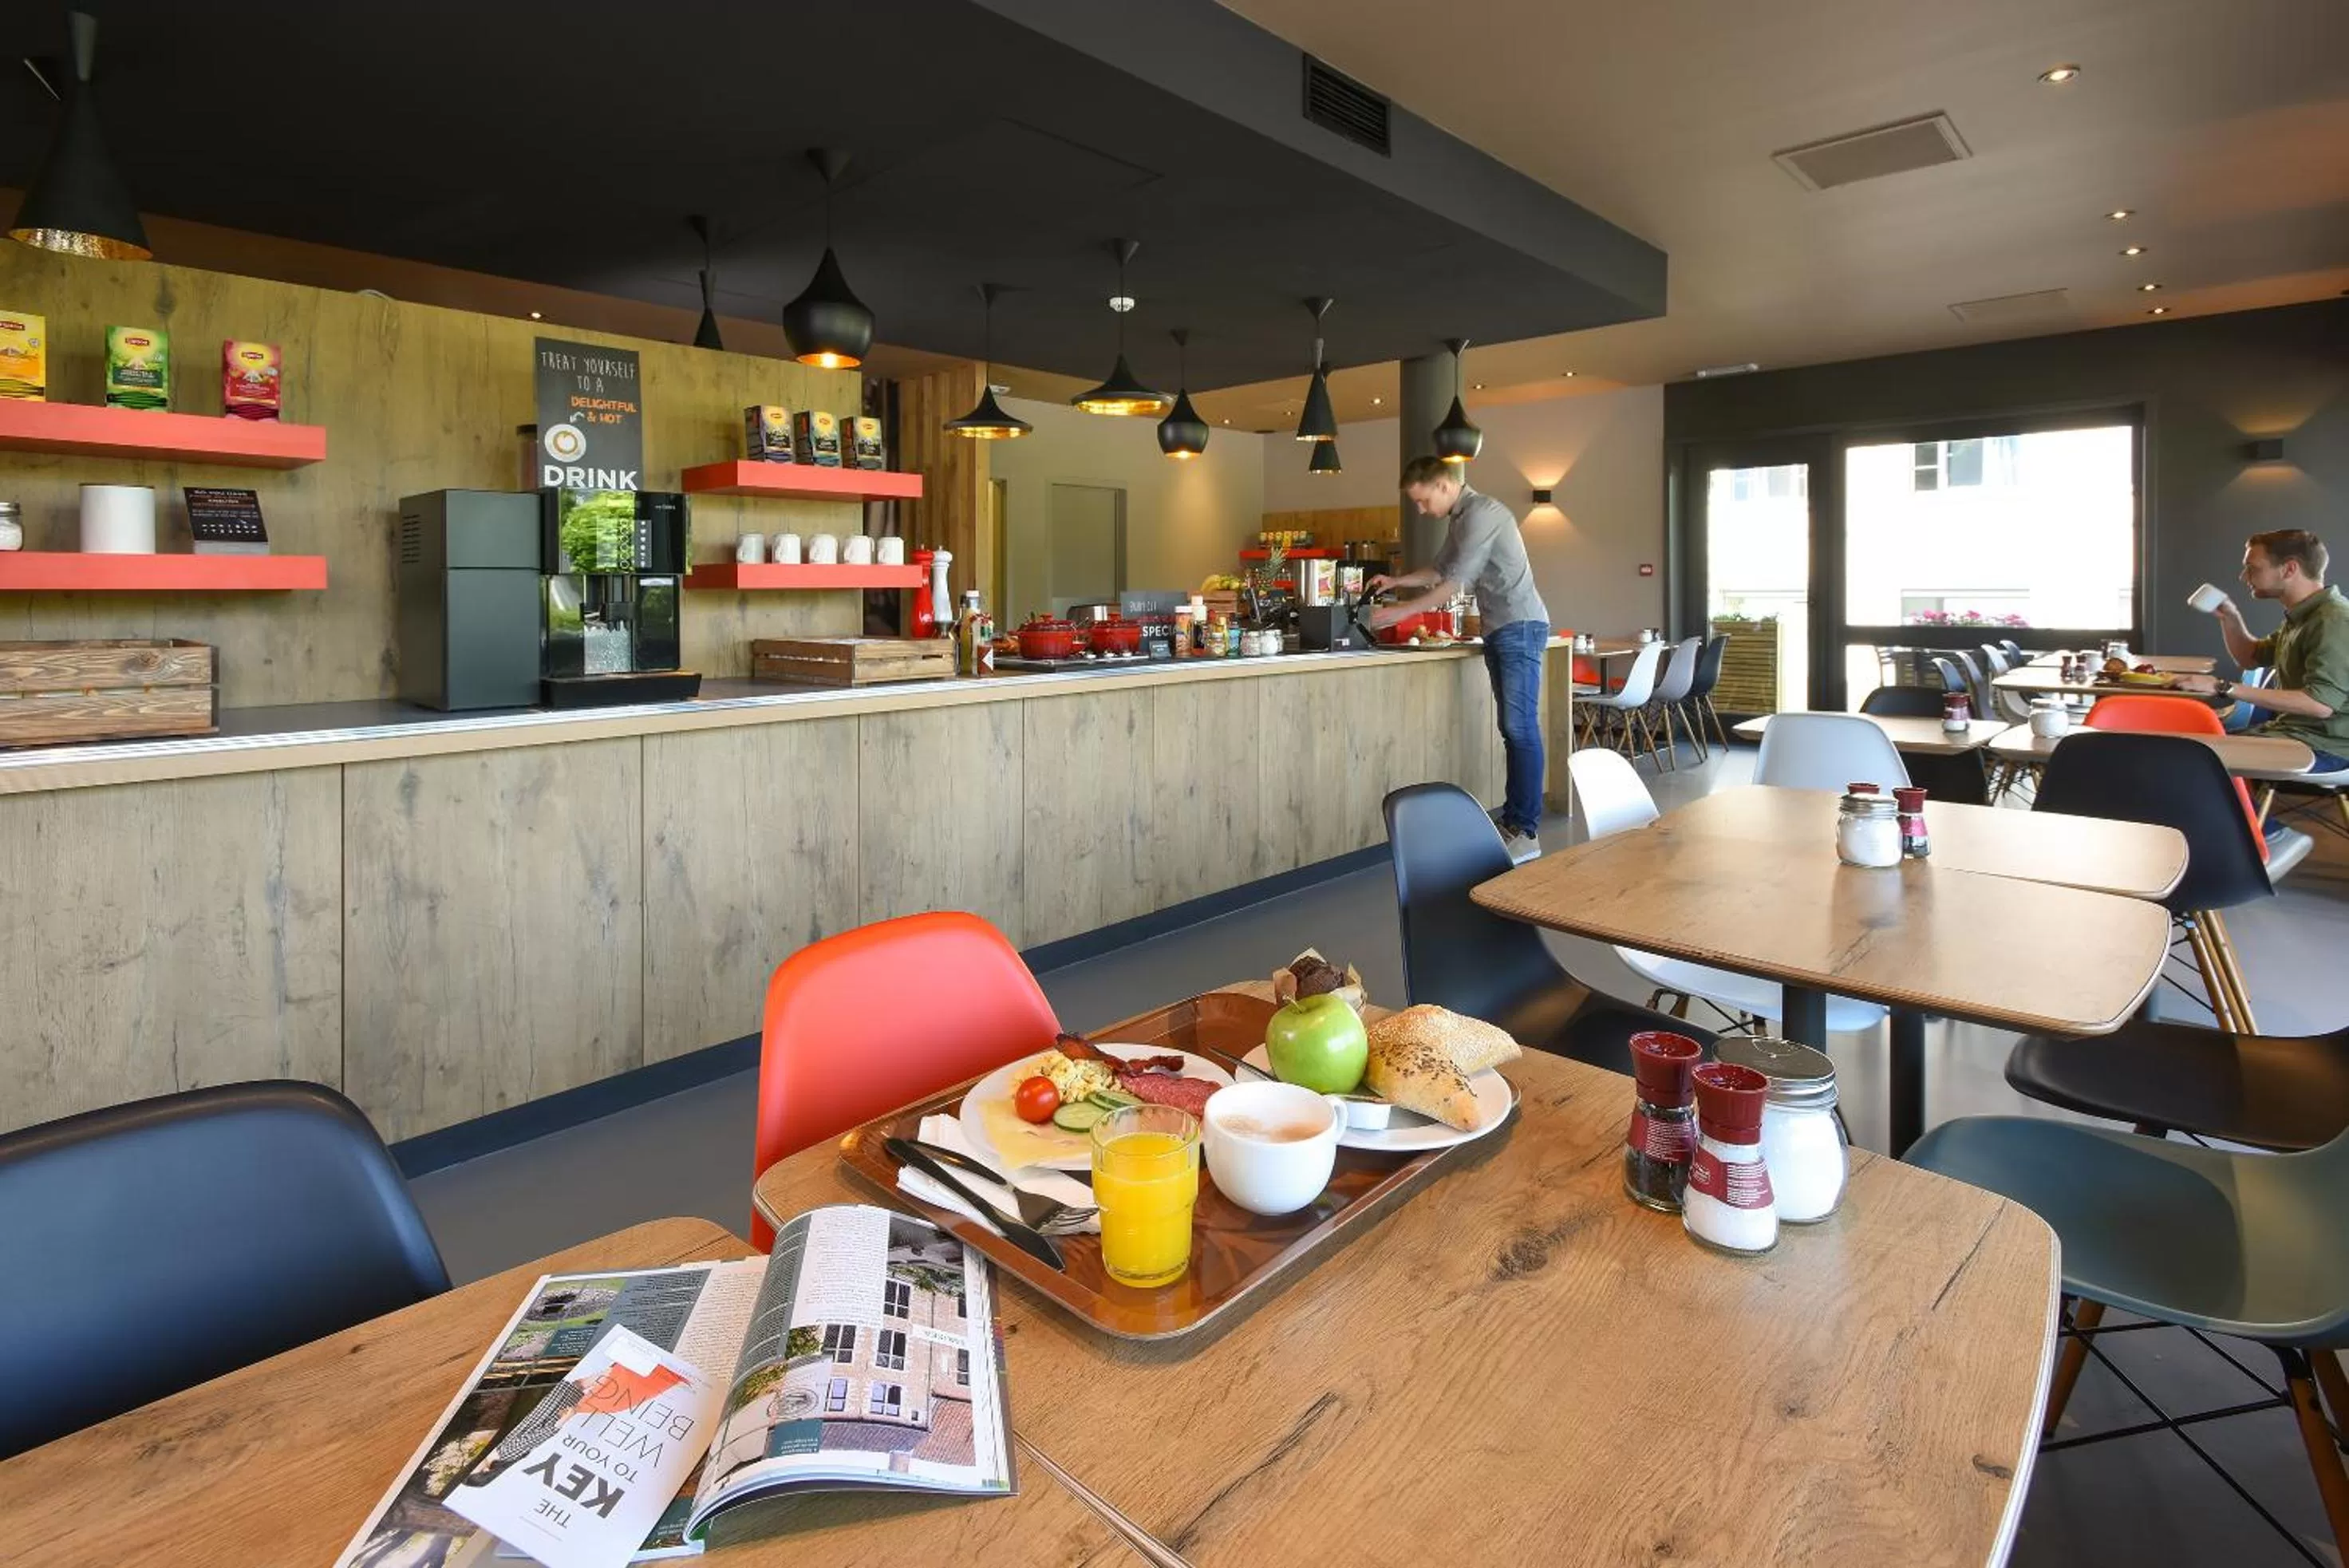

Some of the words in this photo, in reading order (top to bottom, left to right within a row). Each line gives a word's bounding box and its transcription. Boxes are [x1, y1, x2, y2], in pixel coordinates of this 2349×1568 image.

[540, 351, 578, 371] TREAT
[583, 358, 636, 379] YOURSELF
[577, 375, 590, 392] TO
[595, 377, 604, 393] A
[570, 396, 637, 413] DELIGHTFUL
[586, 412, 596, 424] &
[599, 413, 623, 425] HOT
[543, 464, 638, 491] DRINK
[596, 1375, 695, 1442] BEING
[580, 1400, 664, 1467] WELL
[562, 1434, 610, 1469] YOUR
[523, 1452, 626, 1519] KEY
[613, 1462, 638, 1483] TO
[534, 1498, 572, 1529] THE
